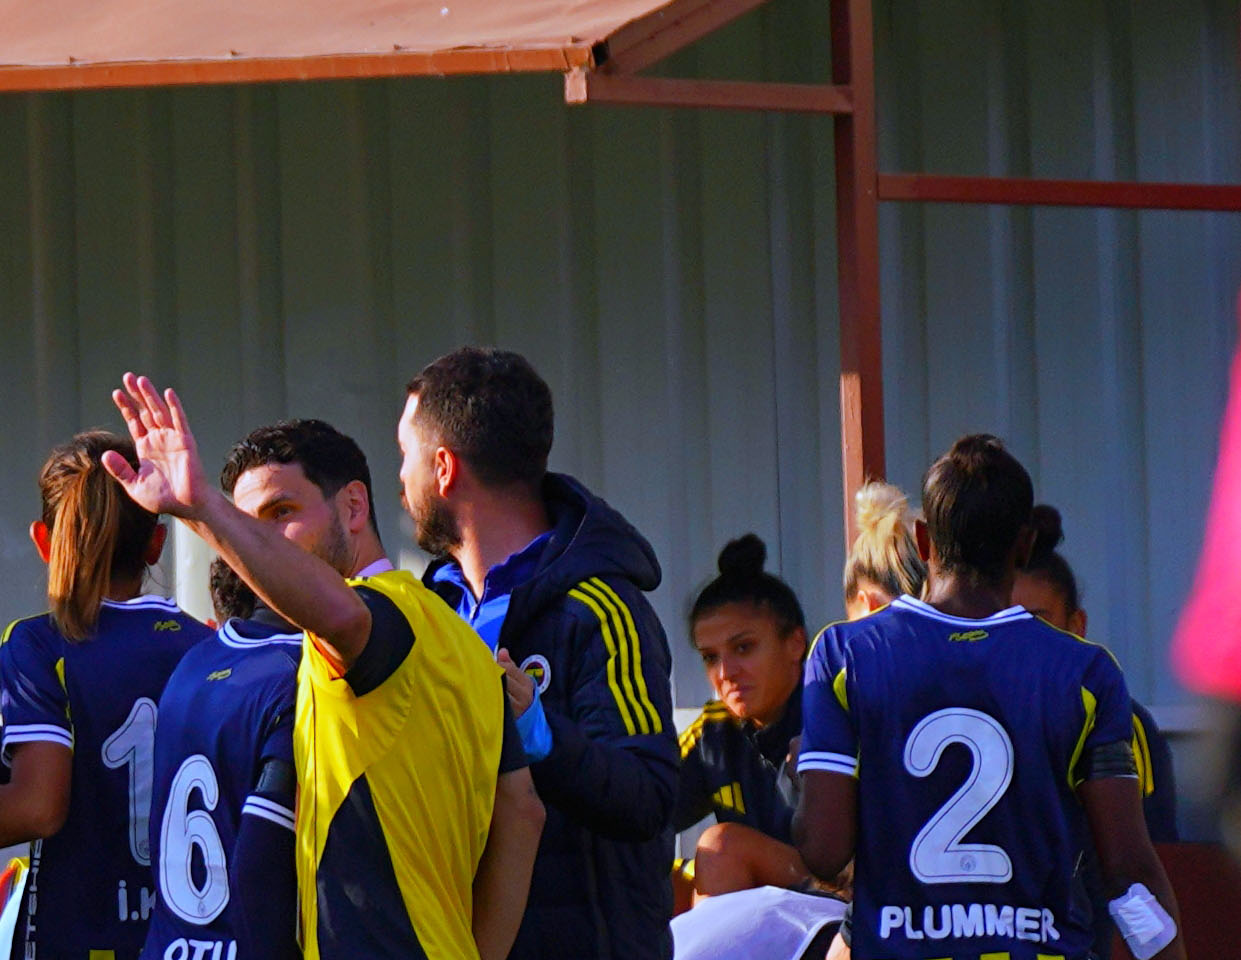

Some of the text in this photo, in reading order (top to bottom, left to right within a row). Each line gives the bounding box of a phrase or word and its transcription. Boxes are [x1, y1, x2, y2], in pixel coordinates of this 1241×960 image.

[160, 754, 230, 925] 6
[903, 707, 1014, 883] 2
[880, 903, 1061, 943] PLUMMER
